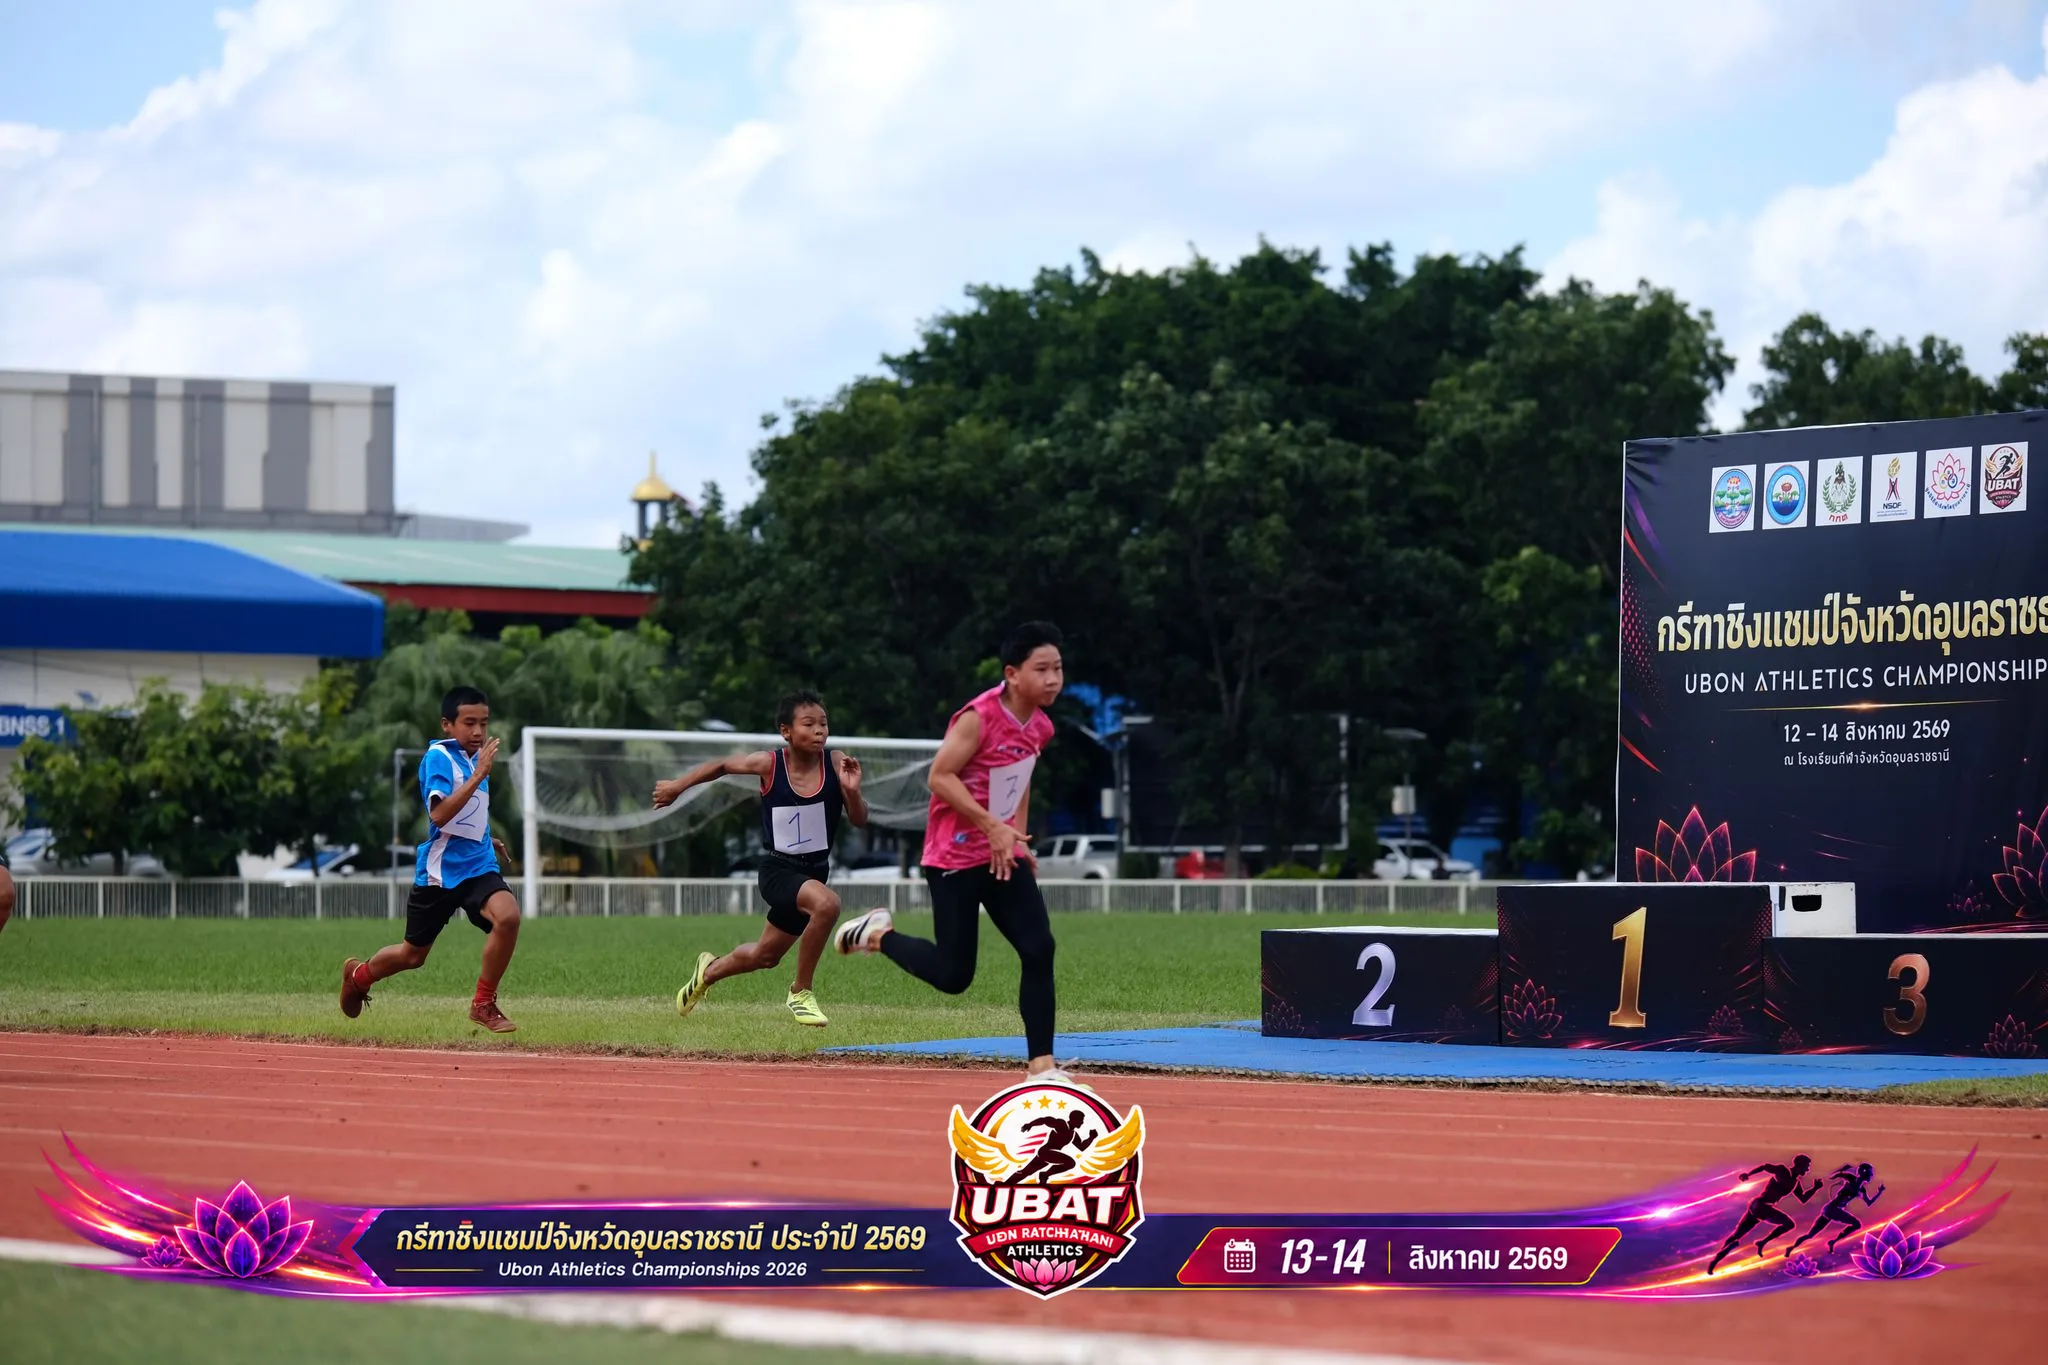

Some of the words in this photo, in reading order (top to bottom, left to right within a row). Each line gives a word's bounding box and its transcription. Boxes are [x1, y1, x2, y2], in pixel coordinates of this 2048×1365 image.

[1988, 478, 2019, 491] UBAT
[1883, 502, 1901, 510] NSDF
[1685, 672, 1744, 694] UBON
[1755, 667, 1873, 691] ATHLETICS
[1883, 658, 2047, 687] CHAMPIONSHIP
[56, 716, 65, 735] 1
[1784, 724, 1800, 742] 12
[1822, 723, 1838, 741] 14
[1845, 721, 1906, 741] สิงหาคม
[1912, 719, 1950, 739] 2569
[1784, 755, 1793, 765] ณ
[1798, 748, 1950, 767] โรงเรียนกีฬาจังหวัดอุบลราชธานี
[456, 795, 480, 828] 2
[787, 812, 812, 847] 1
[1609, 906, 1647, 1027] 1
[1352, 942, 1396, 1027] 2
[1883, 952, 1931, 1036] 3
